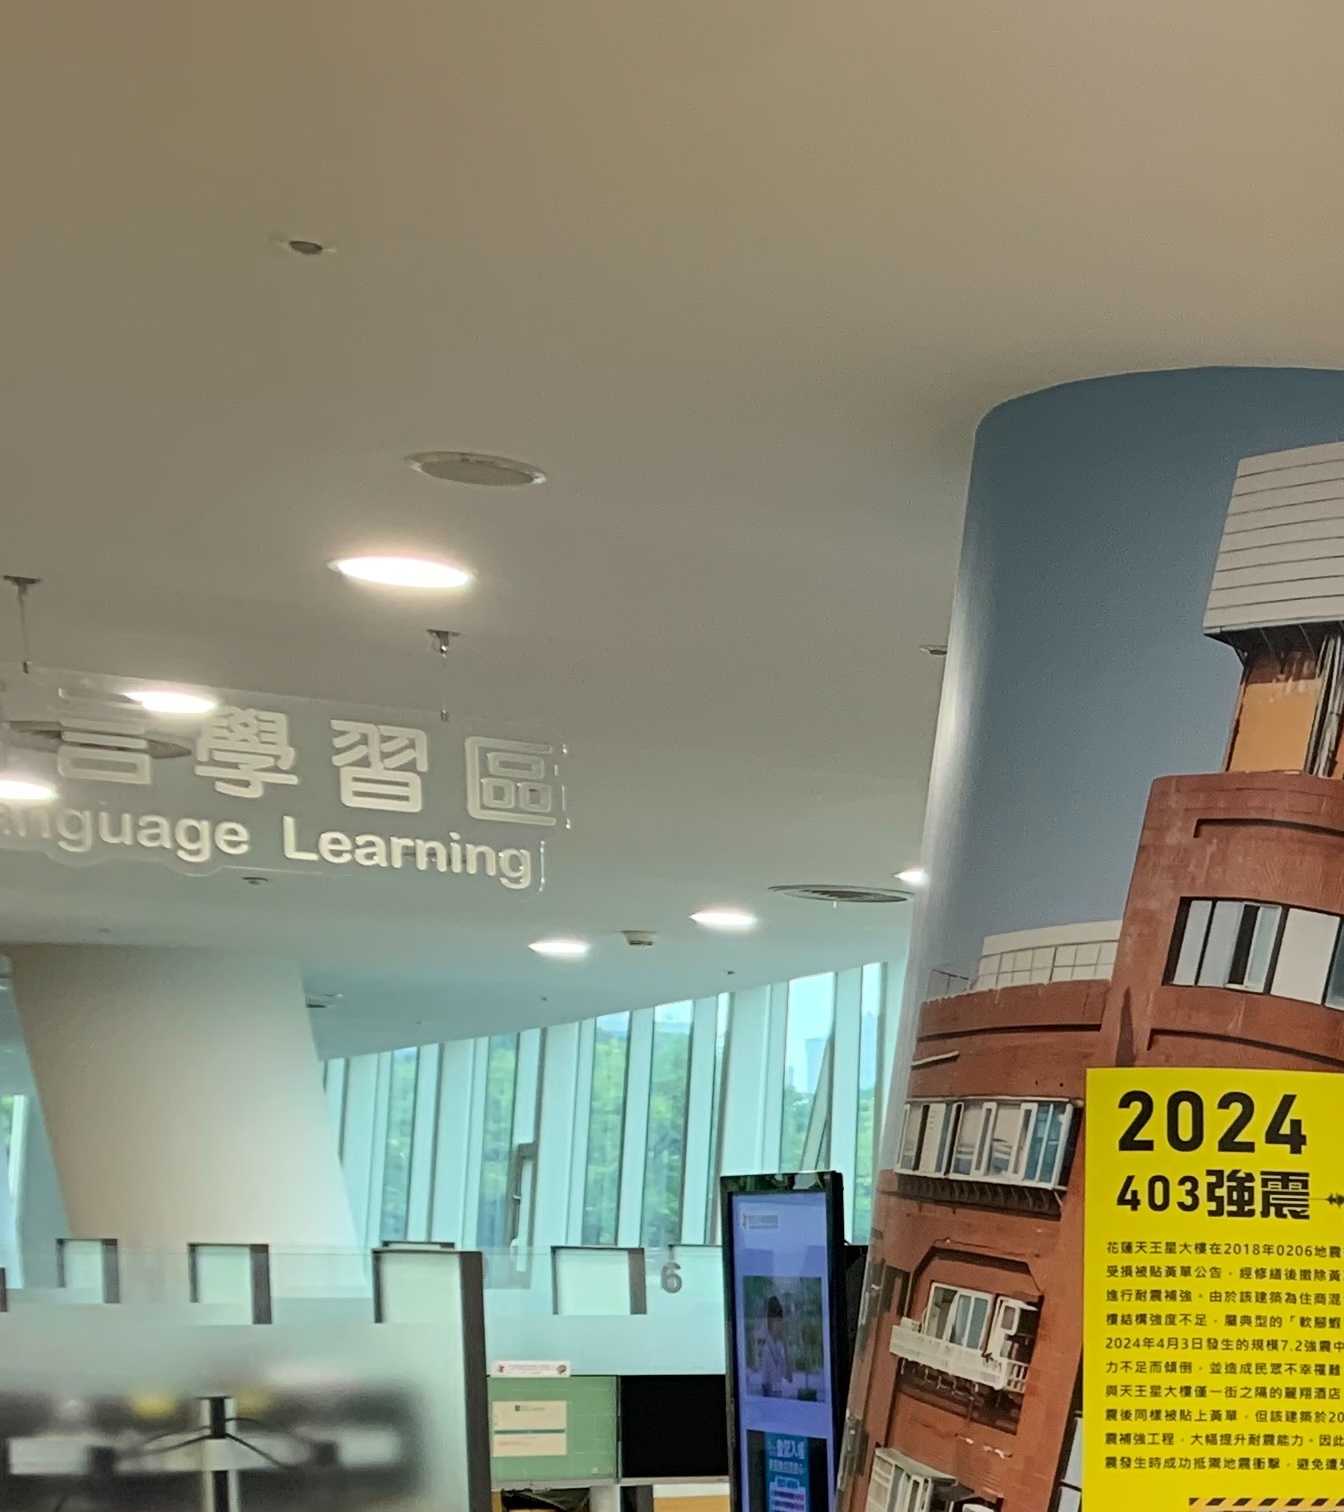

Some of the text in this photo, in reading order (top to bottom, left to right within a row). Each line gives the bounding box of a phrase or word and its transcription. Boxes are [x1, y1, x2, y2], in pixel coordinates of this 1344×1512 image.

[0, 686, 558, 826] 言學習區
[283, 815, 532, 892] Learning
[1118, 1090, 1307, 1154] 2024
[1116, 1169, 1310, 1220] 403強震
[661, 1262, 682, 1293] 6
